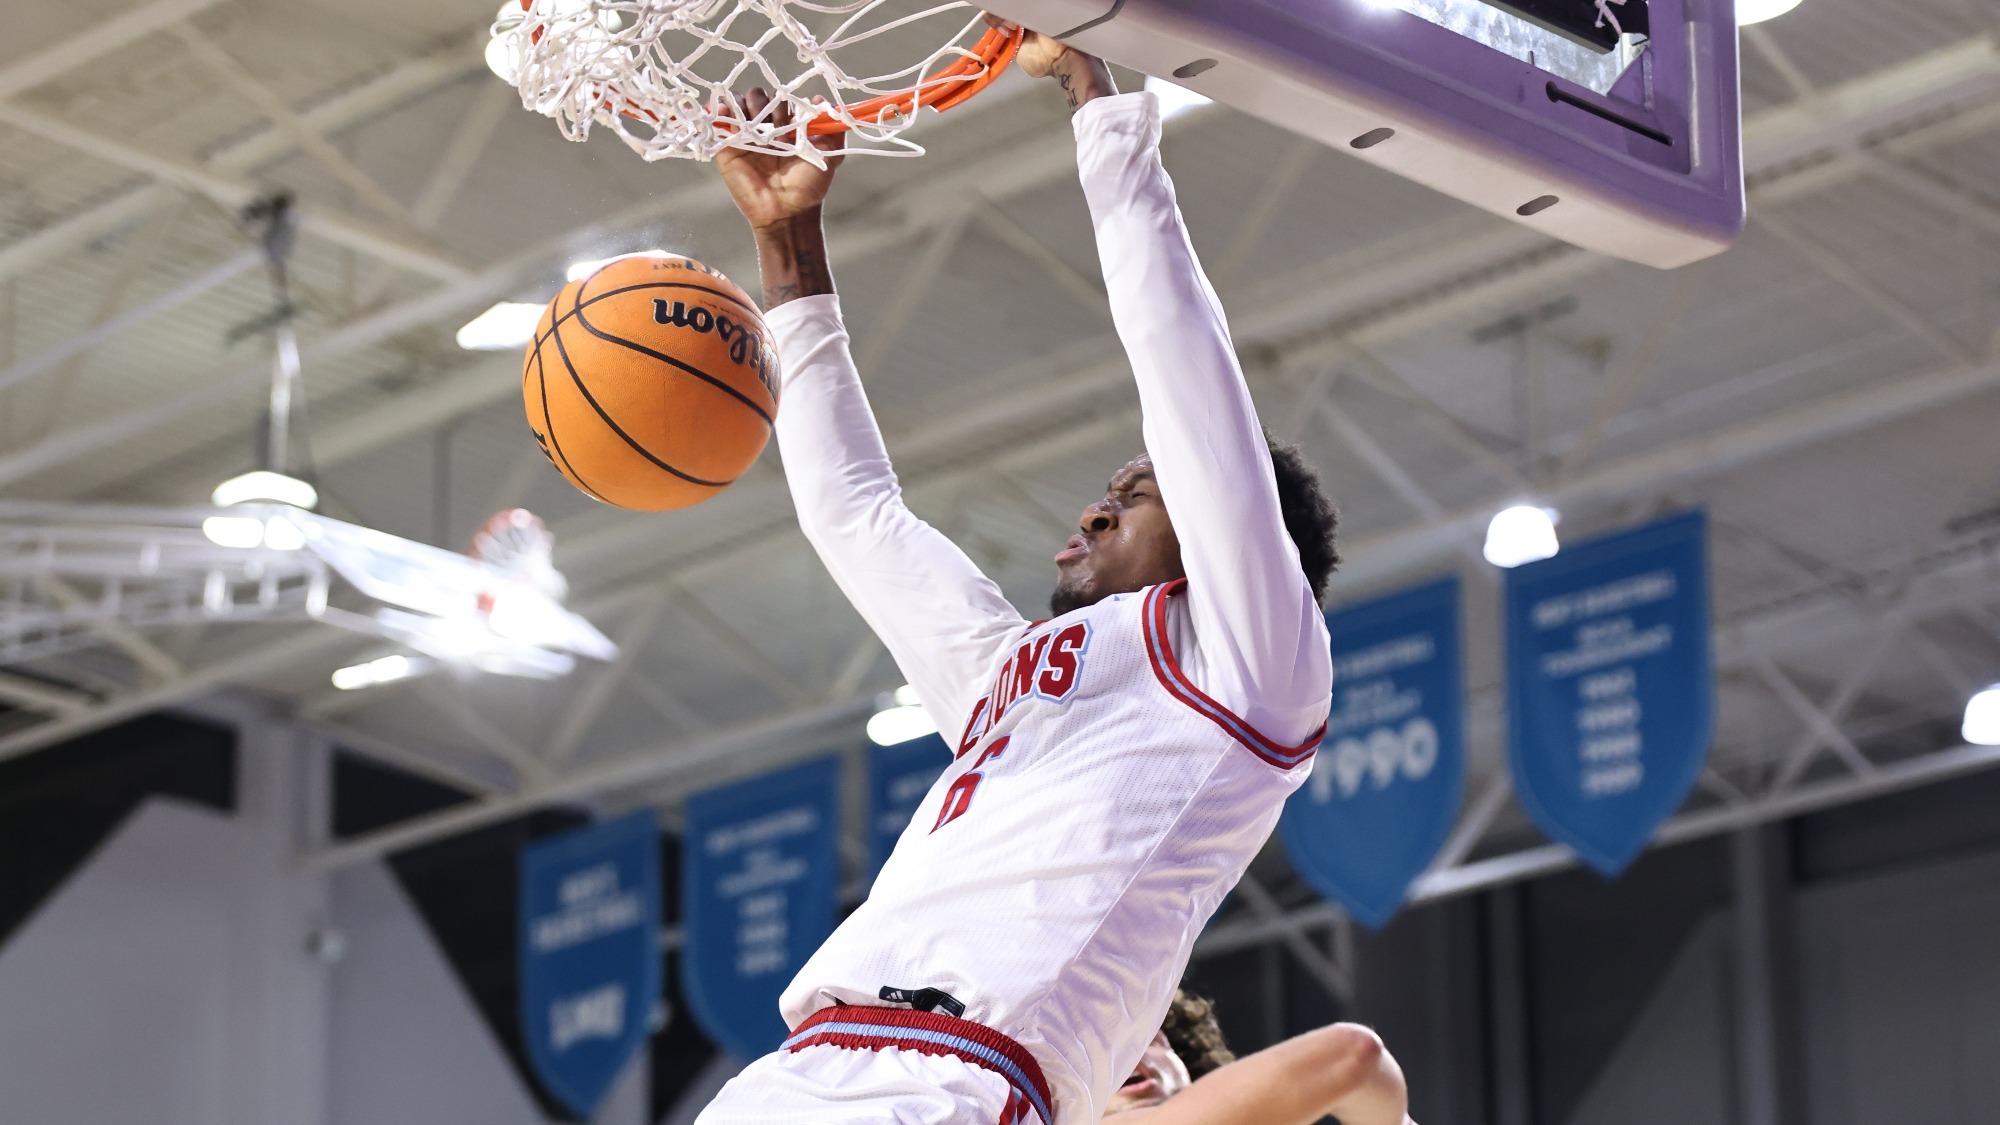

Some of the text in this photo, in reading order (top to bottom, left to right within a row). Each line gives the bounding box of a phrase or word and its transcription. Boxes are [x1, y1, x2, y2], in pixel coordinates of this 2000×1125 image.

[954, 619, 1093, 762] LIONS
[928, 734, 1011, 836] 6
[1311, 717, 1438, 803] 1990
